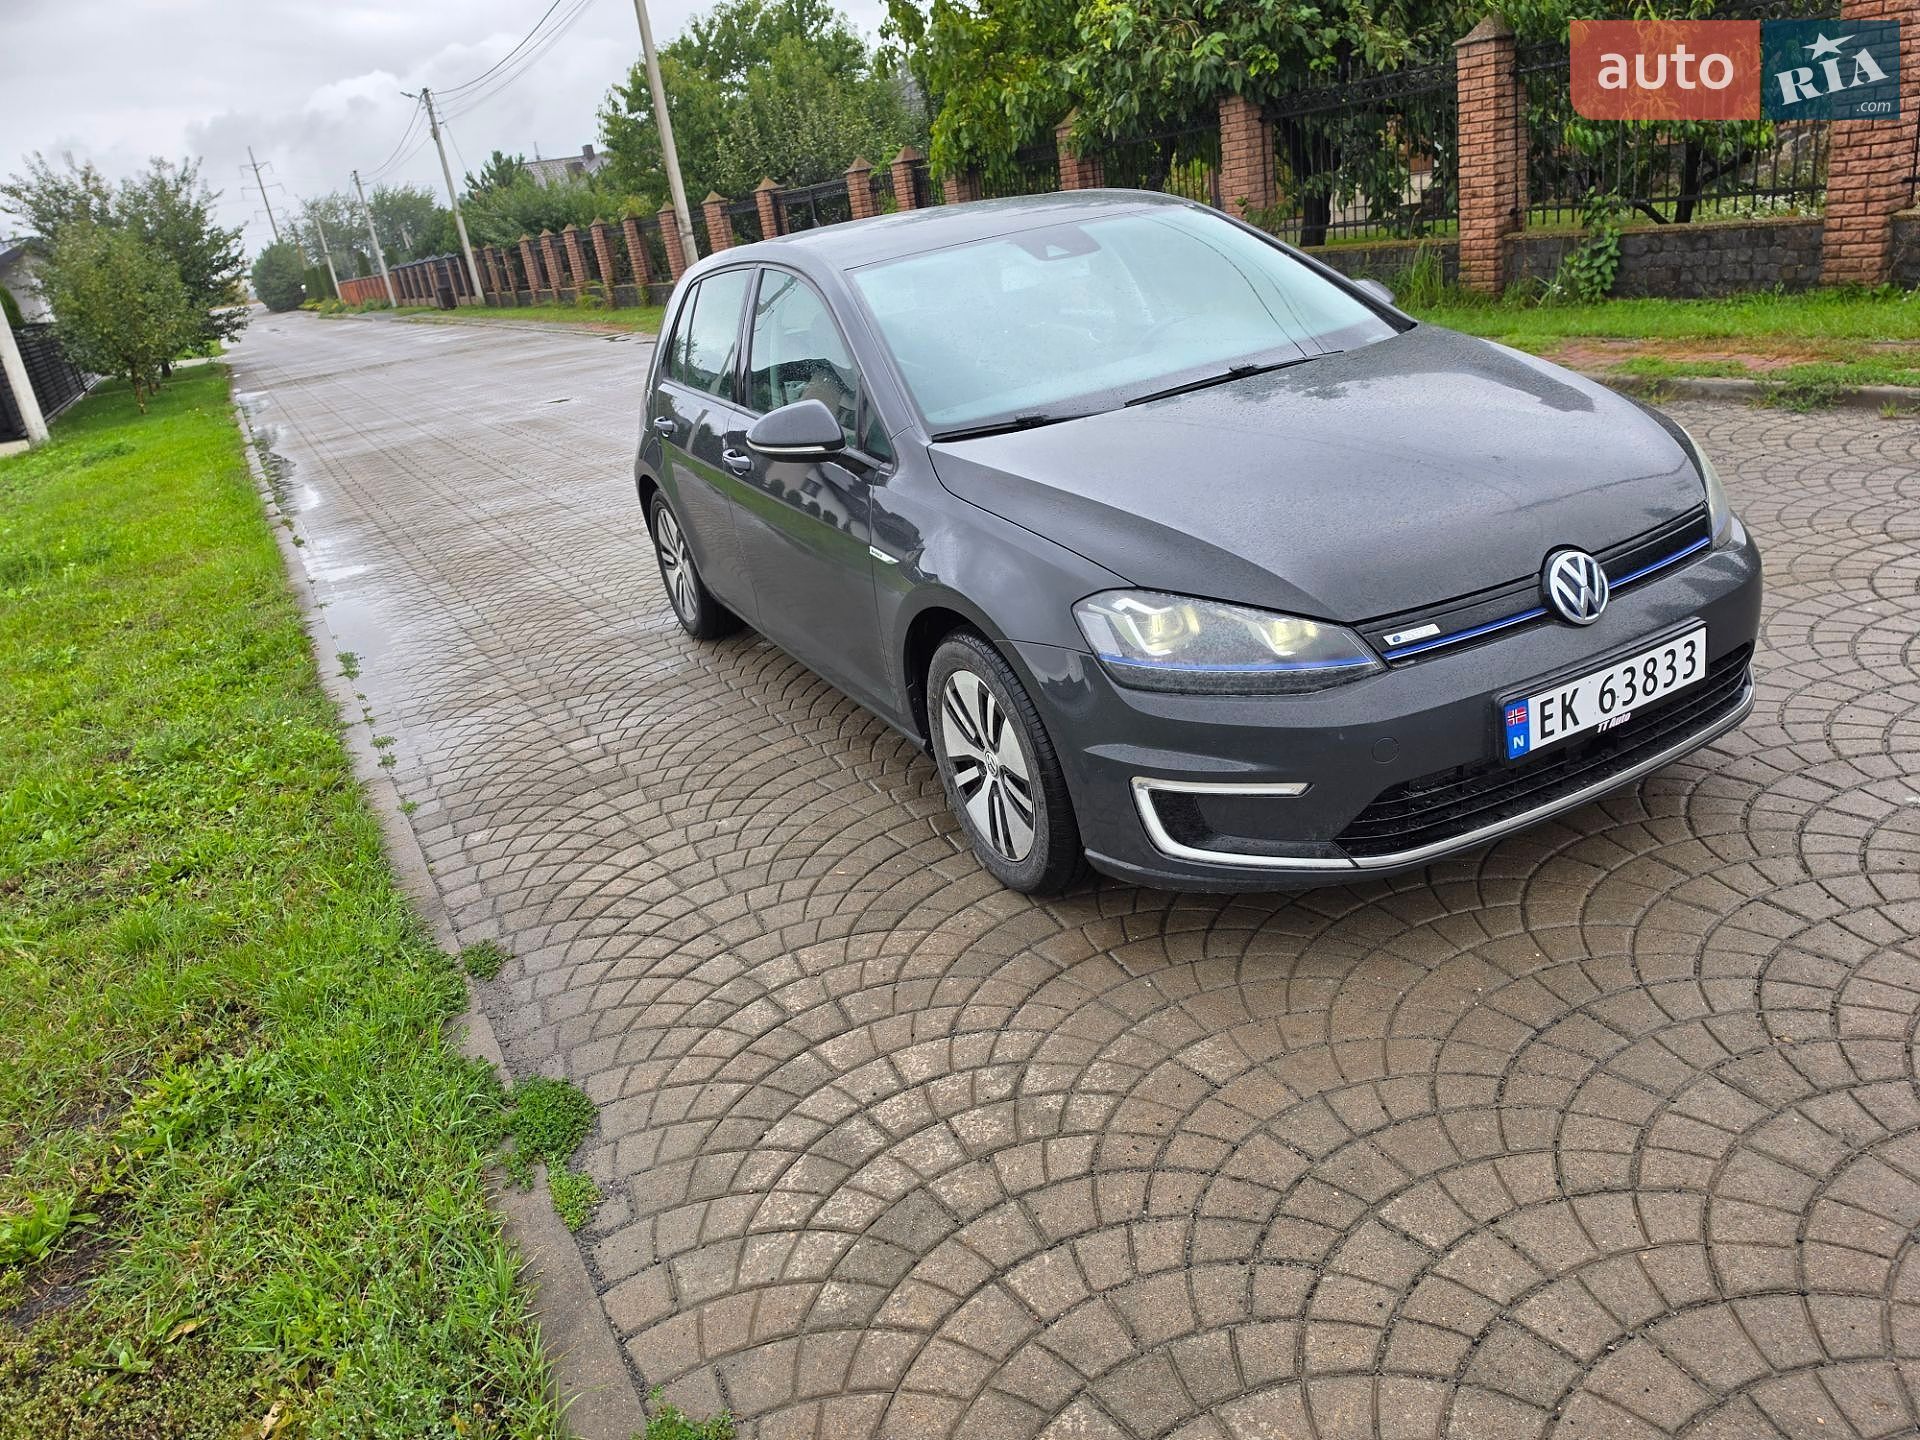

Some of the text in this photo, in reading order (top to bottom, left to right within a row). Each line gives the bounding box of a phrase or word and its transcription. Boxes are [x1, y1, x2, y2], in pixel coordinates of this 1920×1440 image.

[1540, 640, 1696, 740] EK 63833
[1513, 735, 1524, 749] N
